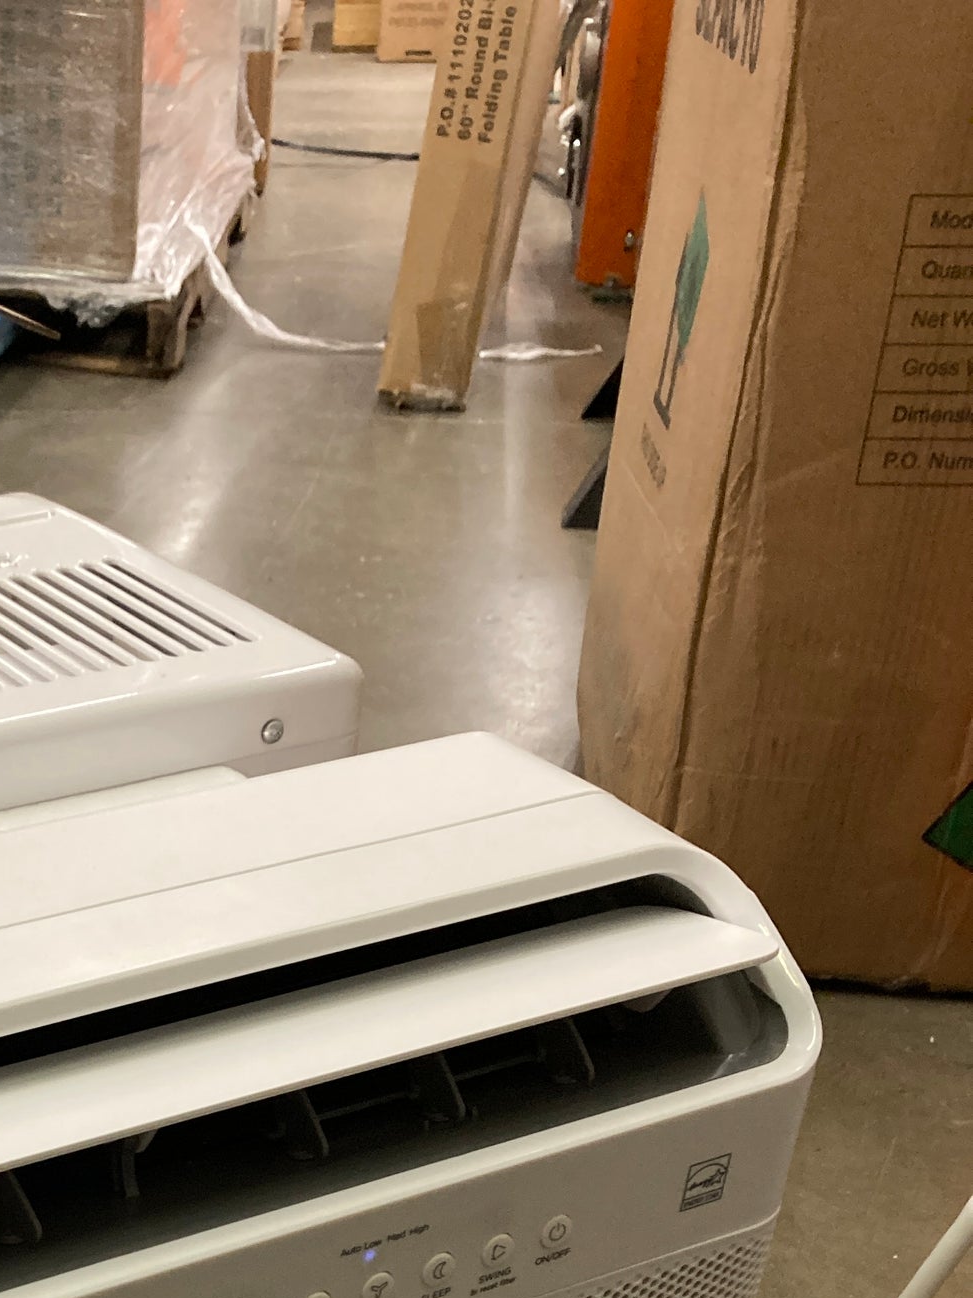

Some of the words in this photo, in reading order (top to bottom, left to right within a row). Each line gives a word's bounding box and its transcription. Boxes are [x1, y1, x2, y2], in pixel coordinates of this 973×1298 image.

[492, 6, 517, 63] Table
[465, 35, 489, 100] Round
[478, 69, 508, 143] Folding
[911, 309, 947, 328] Net
[902, 358, 959, 376] Gross
[883, 450, 922, 470] P.O.
[340, 1246, 362, 1257] Auto
[363, 1239, 382, 1251] Low
[534, 1247, 571, 1266] ON/OFF
[478, 1266, 512, 1284] SWING
